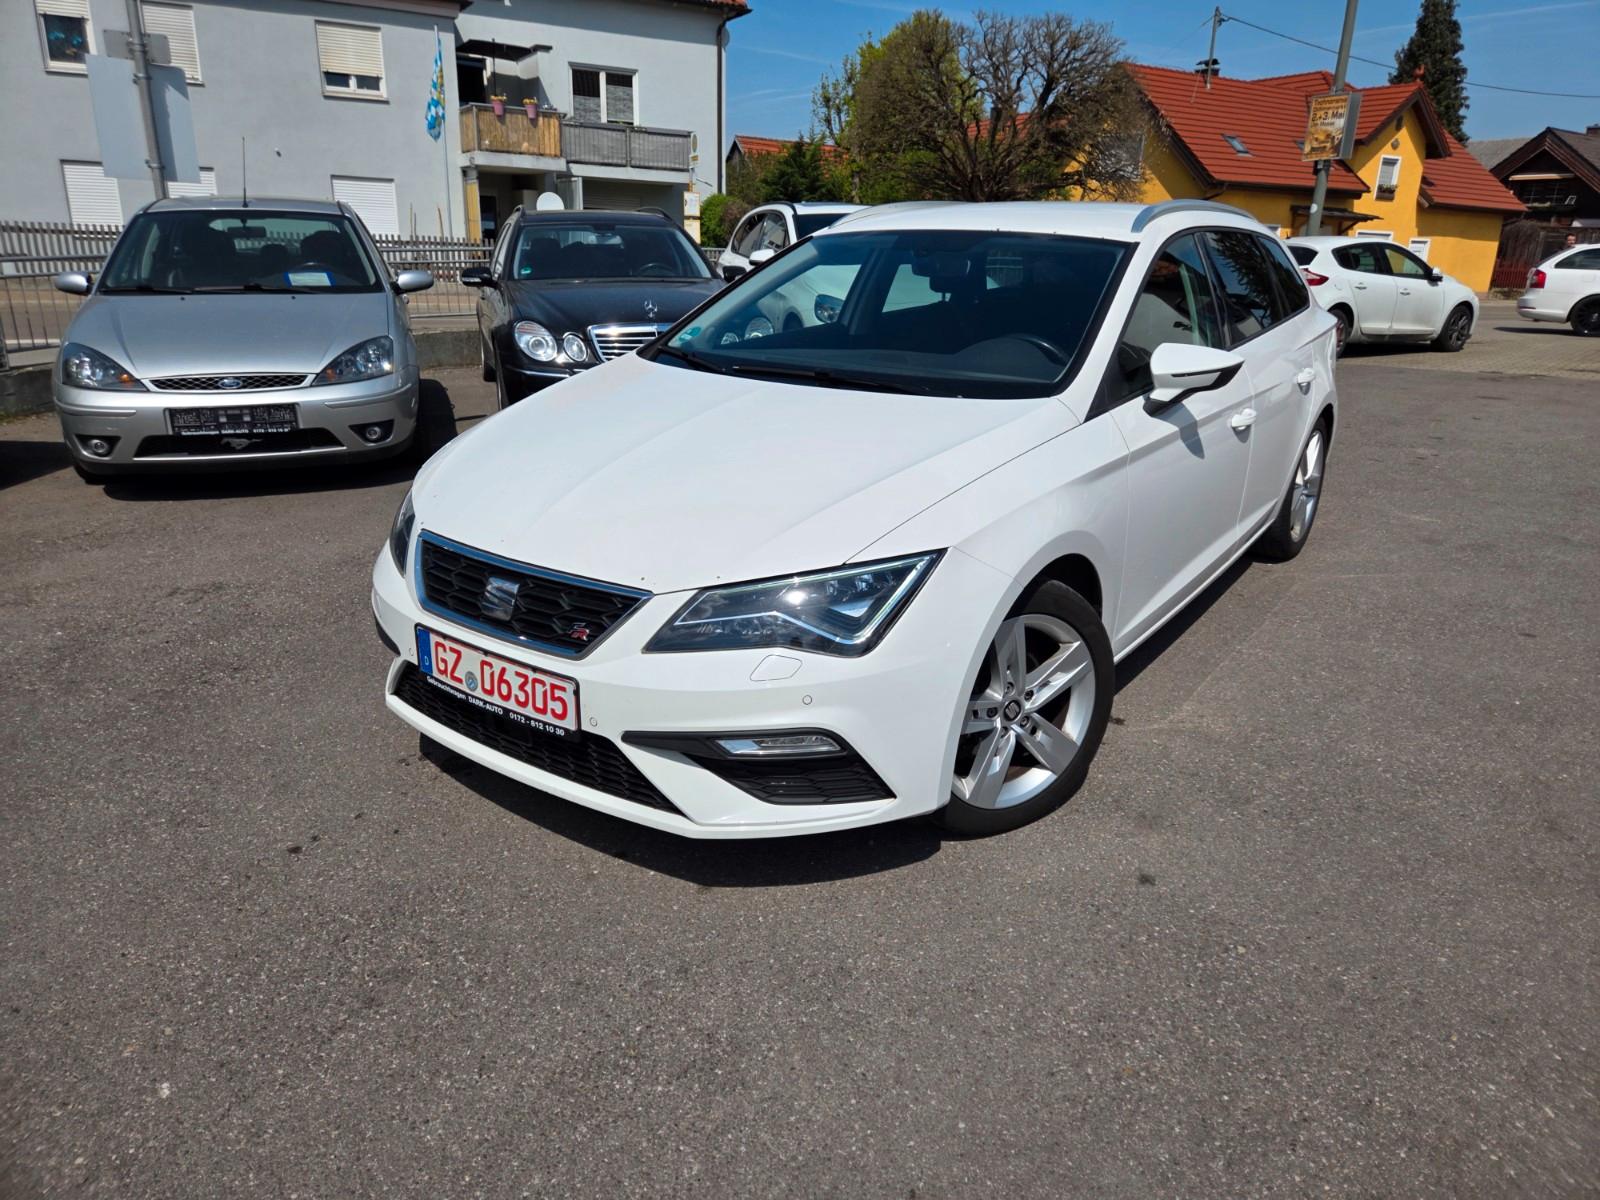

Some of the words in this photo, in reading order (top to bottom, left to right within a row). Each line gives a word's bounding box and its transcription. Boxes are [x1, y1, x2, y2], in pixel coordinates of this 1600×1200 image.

[424, 655, 430, 666] D
[434, 640, 464, 685] GZ
[480, 659, 569, 722] 06305
[468, 695, 503, 715] DARK-AUTO
[509, 712, 525, 724] 0172
[530, 719, 544, 730] 812
[545, 724, 554, 733] 10
[555, 728, 565, 736] 30
